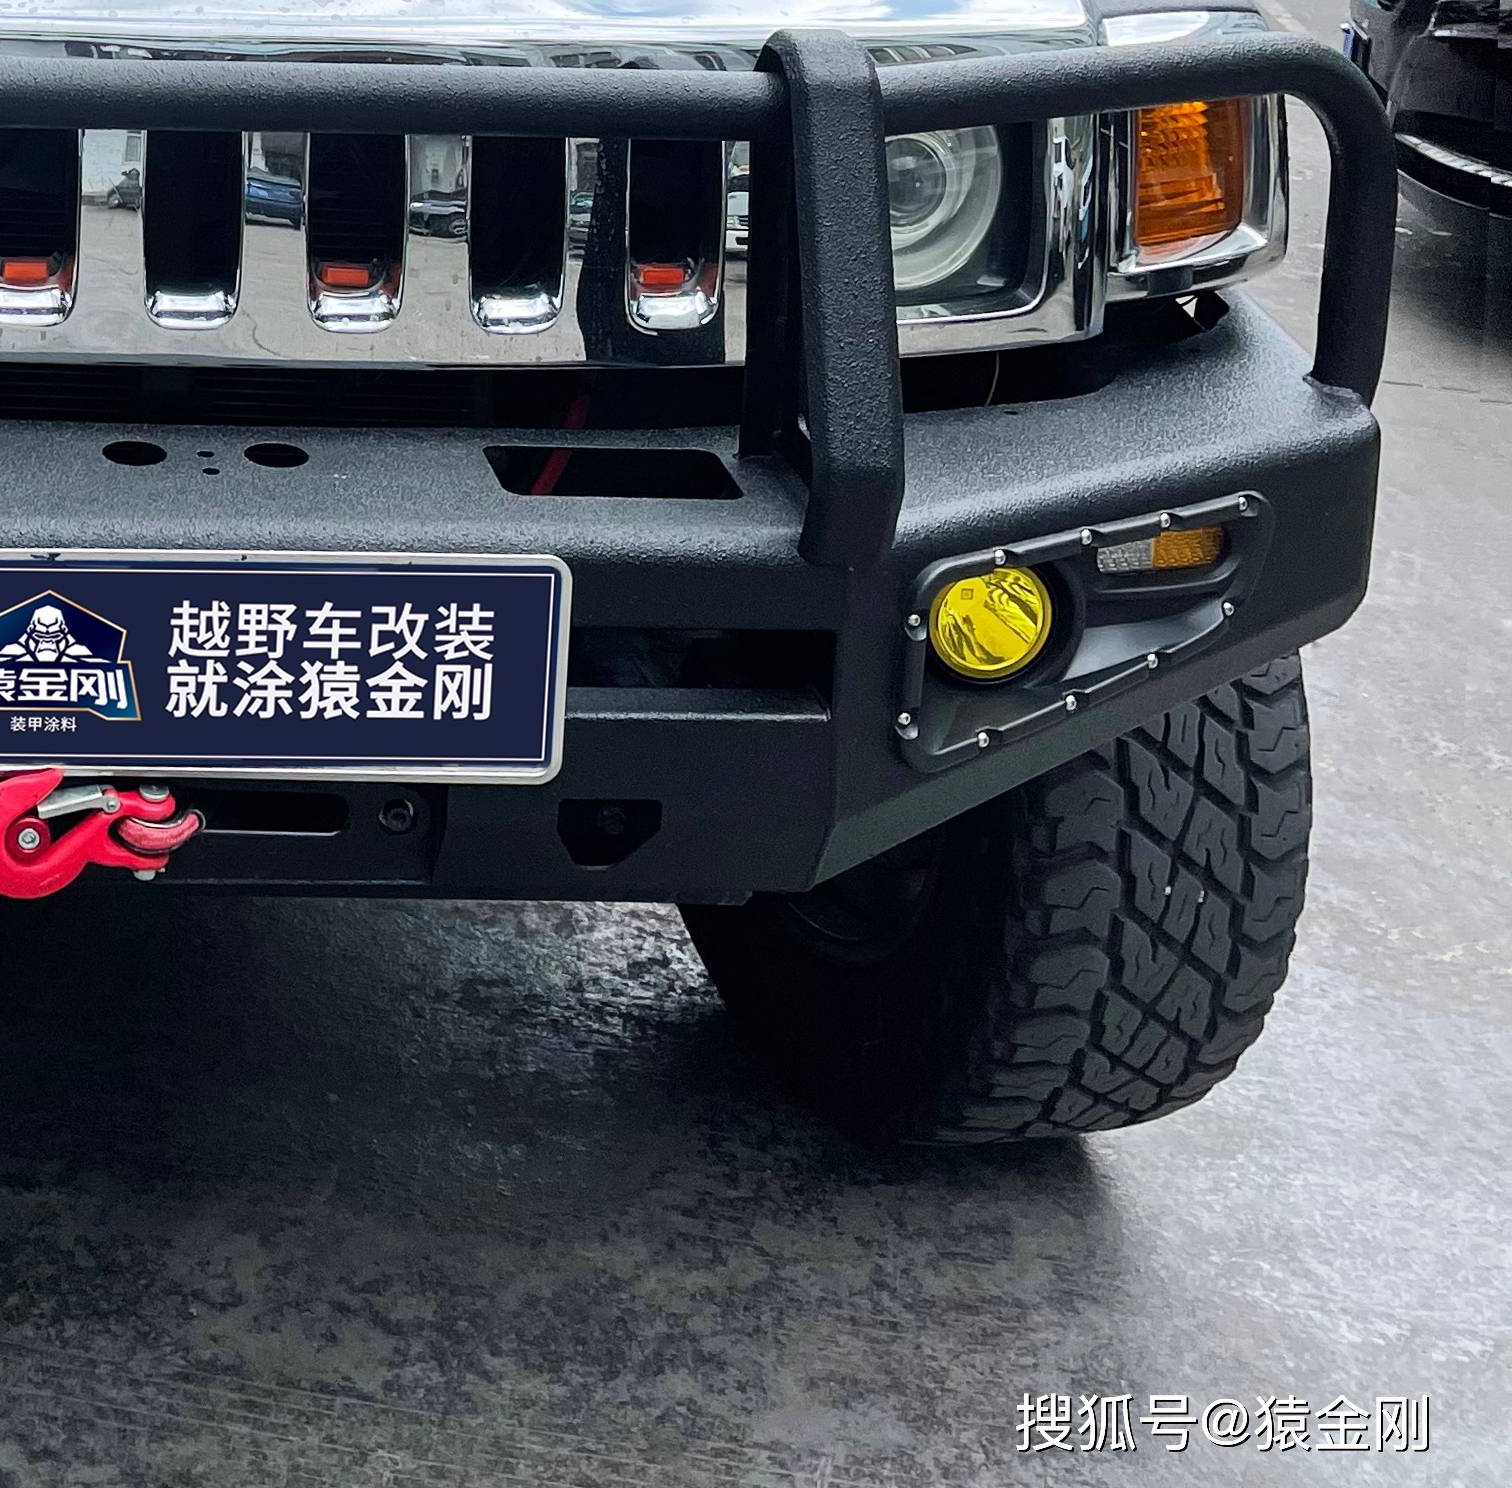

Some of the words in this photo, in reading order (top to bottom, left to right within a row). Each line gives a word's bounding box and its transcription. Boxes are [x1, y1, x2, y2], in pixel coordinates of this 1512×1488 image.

[168, 600, 496, 661] 越野车改装
[165, 659, 494, 721] 就涂猿金刚
[10, 715, 78, 733] 装甲涂料
